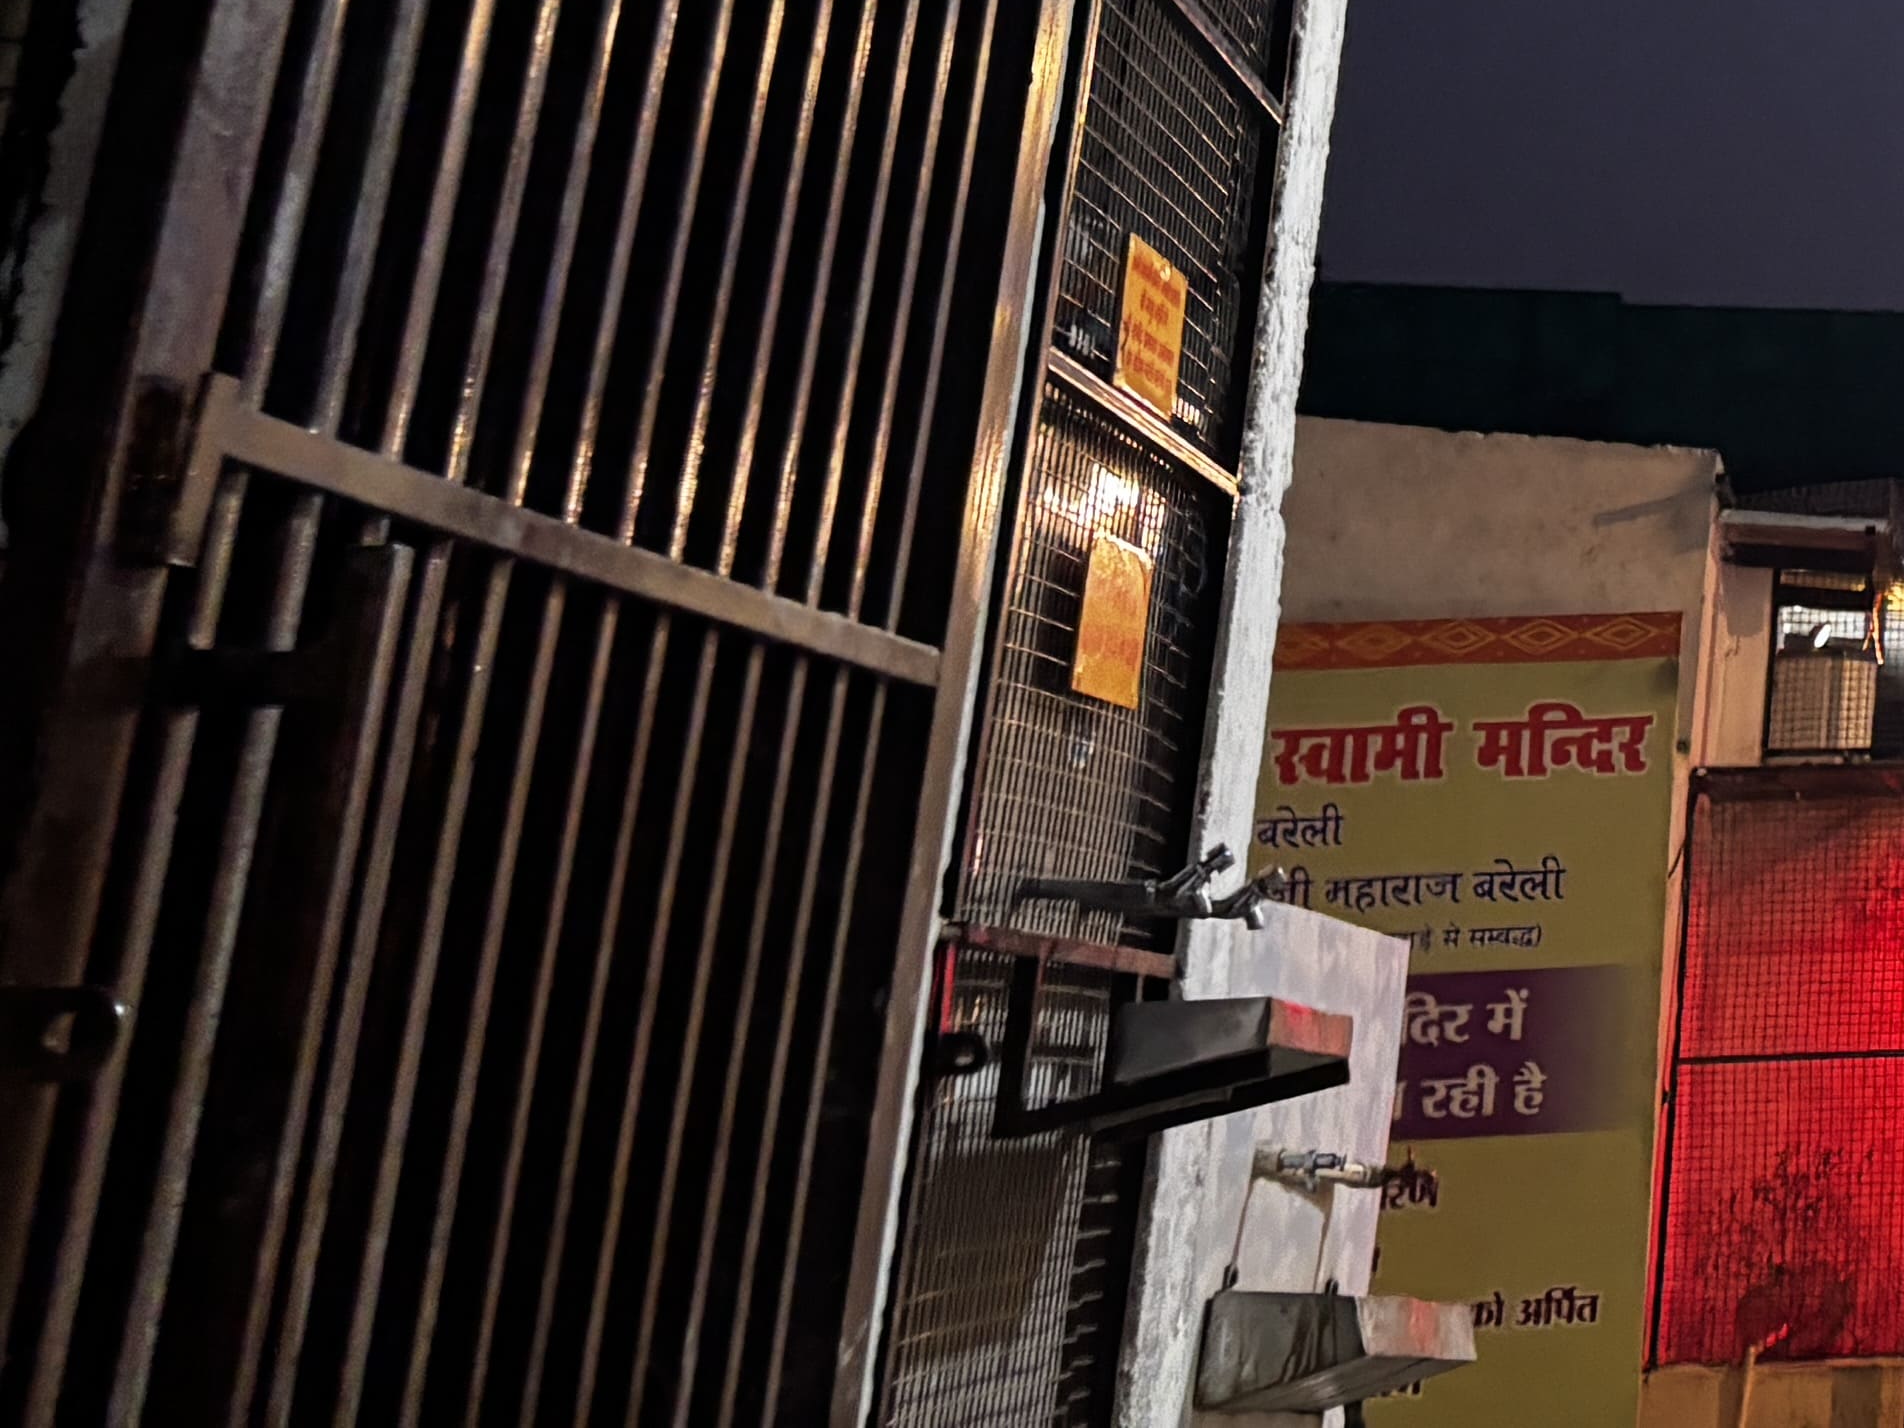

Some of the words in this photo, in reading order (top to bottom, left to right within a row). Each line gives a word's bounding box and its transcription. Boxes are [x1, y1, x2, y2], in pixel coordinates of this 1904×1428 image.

[1272, 706, 1453, 783] स्वामी
[1474, 703, 1653, 776] मन्दिर
[1257, 803, 1343, 846] बरेली
[1326, 873, 1462, 912] महाराज
[1473, 856, 1565, 902] बरेली
[1487, 988, 1531, 1041] में
[1421, 1063, 1500, 1119] रही
[1513, 1062, 1547, 1115] है
[1516, 1286, 1598, 1326] अर्पित
